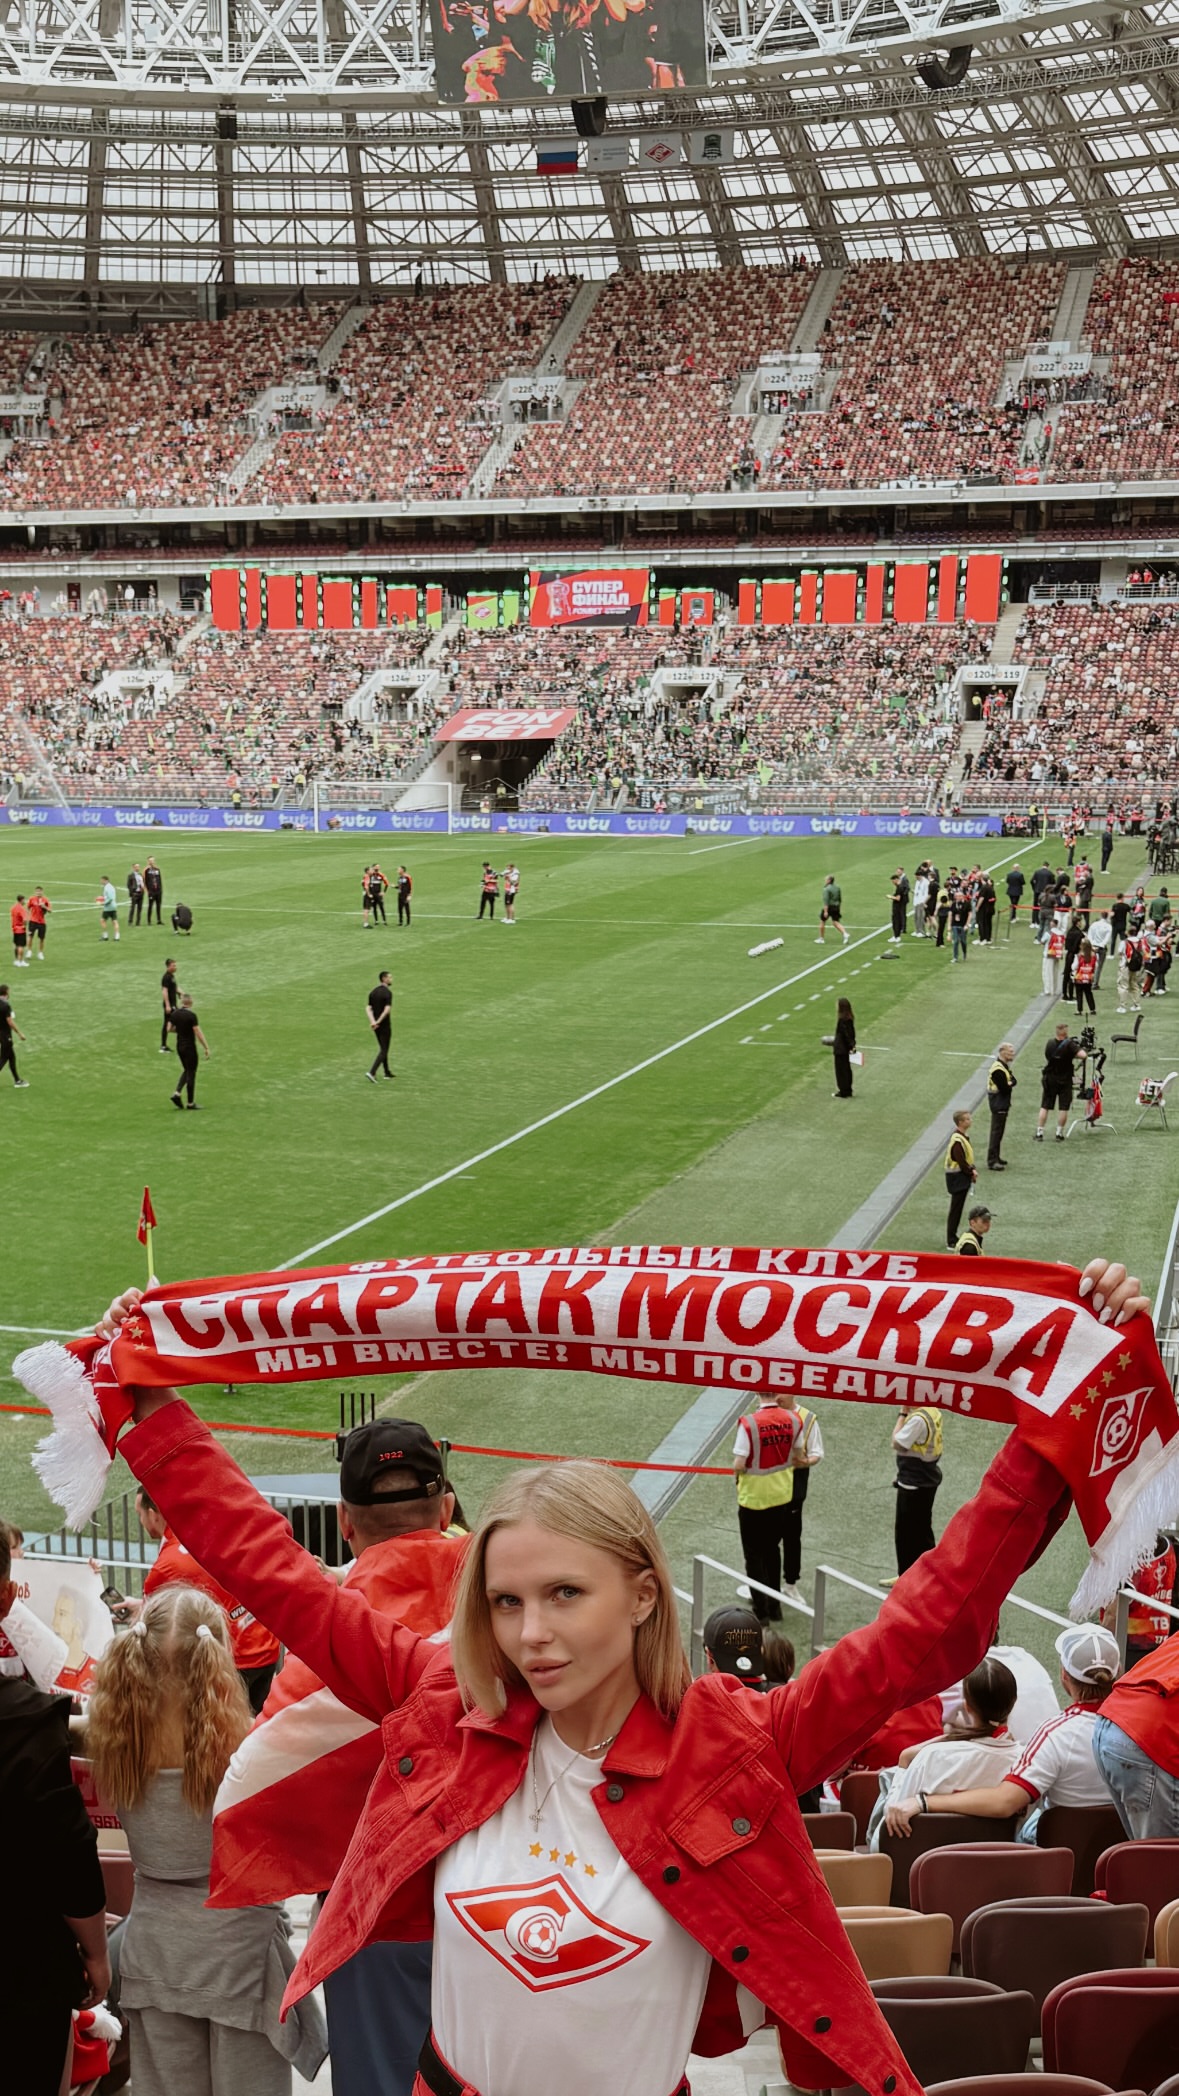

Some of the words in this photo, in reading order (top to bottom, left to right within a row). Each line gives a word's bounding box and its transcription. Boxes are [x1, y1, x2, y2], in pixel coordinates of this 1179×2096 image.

[572, 580, 624, 594] СУПЕР
[572, 593, 630, 606] ФИНАЛ
[464, 711, 565, 725] FON
[450, 724, 553, 738] BET
[115, 810, 155, 824] tutu
[168, 811, 210, 825] tutu
[223, 812, 265, 826] tutu
[391, 814, 434, 829] tutu
[566, 816, 611, 831] tutu
[625, 816, 671, 832] tutu
[686, 817, 732, 832] tutu
[748, 818, 795, 833] tutu
[810, 818, 858, 833] tutu
[874, 818, 922, 834] tutu
[940, 819, 988, 834] tutu
[757, 1248, 919, 1281] КЛУБ
[162, 1270, 607, 1350] СПАРТАК
[616, 1270, 1078, 1398] МОСКВА
[255, 1341, 338, 1374] МЫ
[356, 1339, 569, 1365] ВМЕСТЕ!
[590, 1346, 677, 1377] МЫ
[693, 1354, 974, 1412] ПОБЕДИМ!
